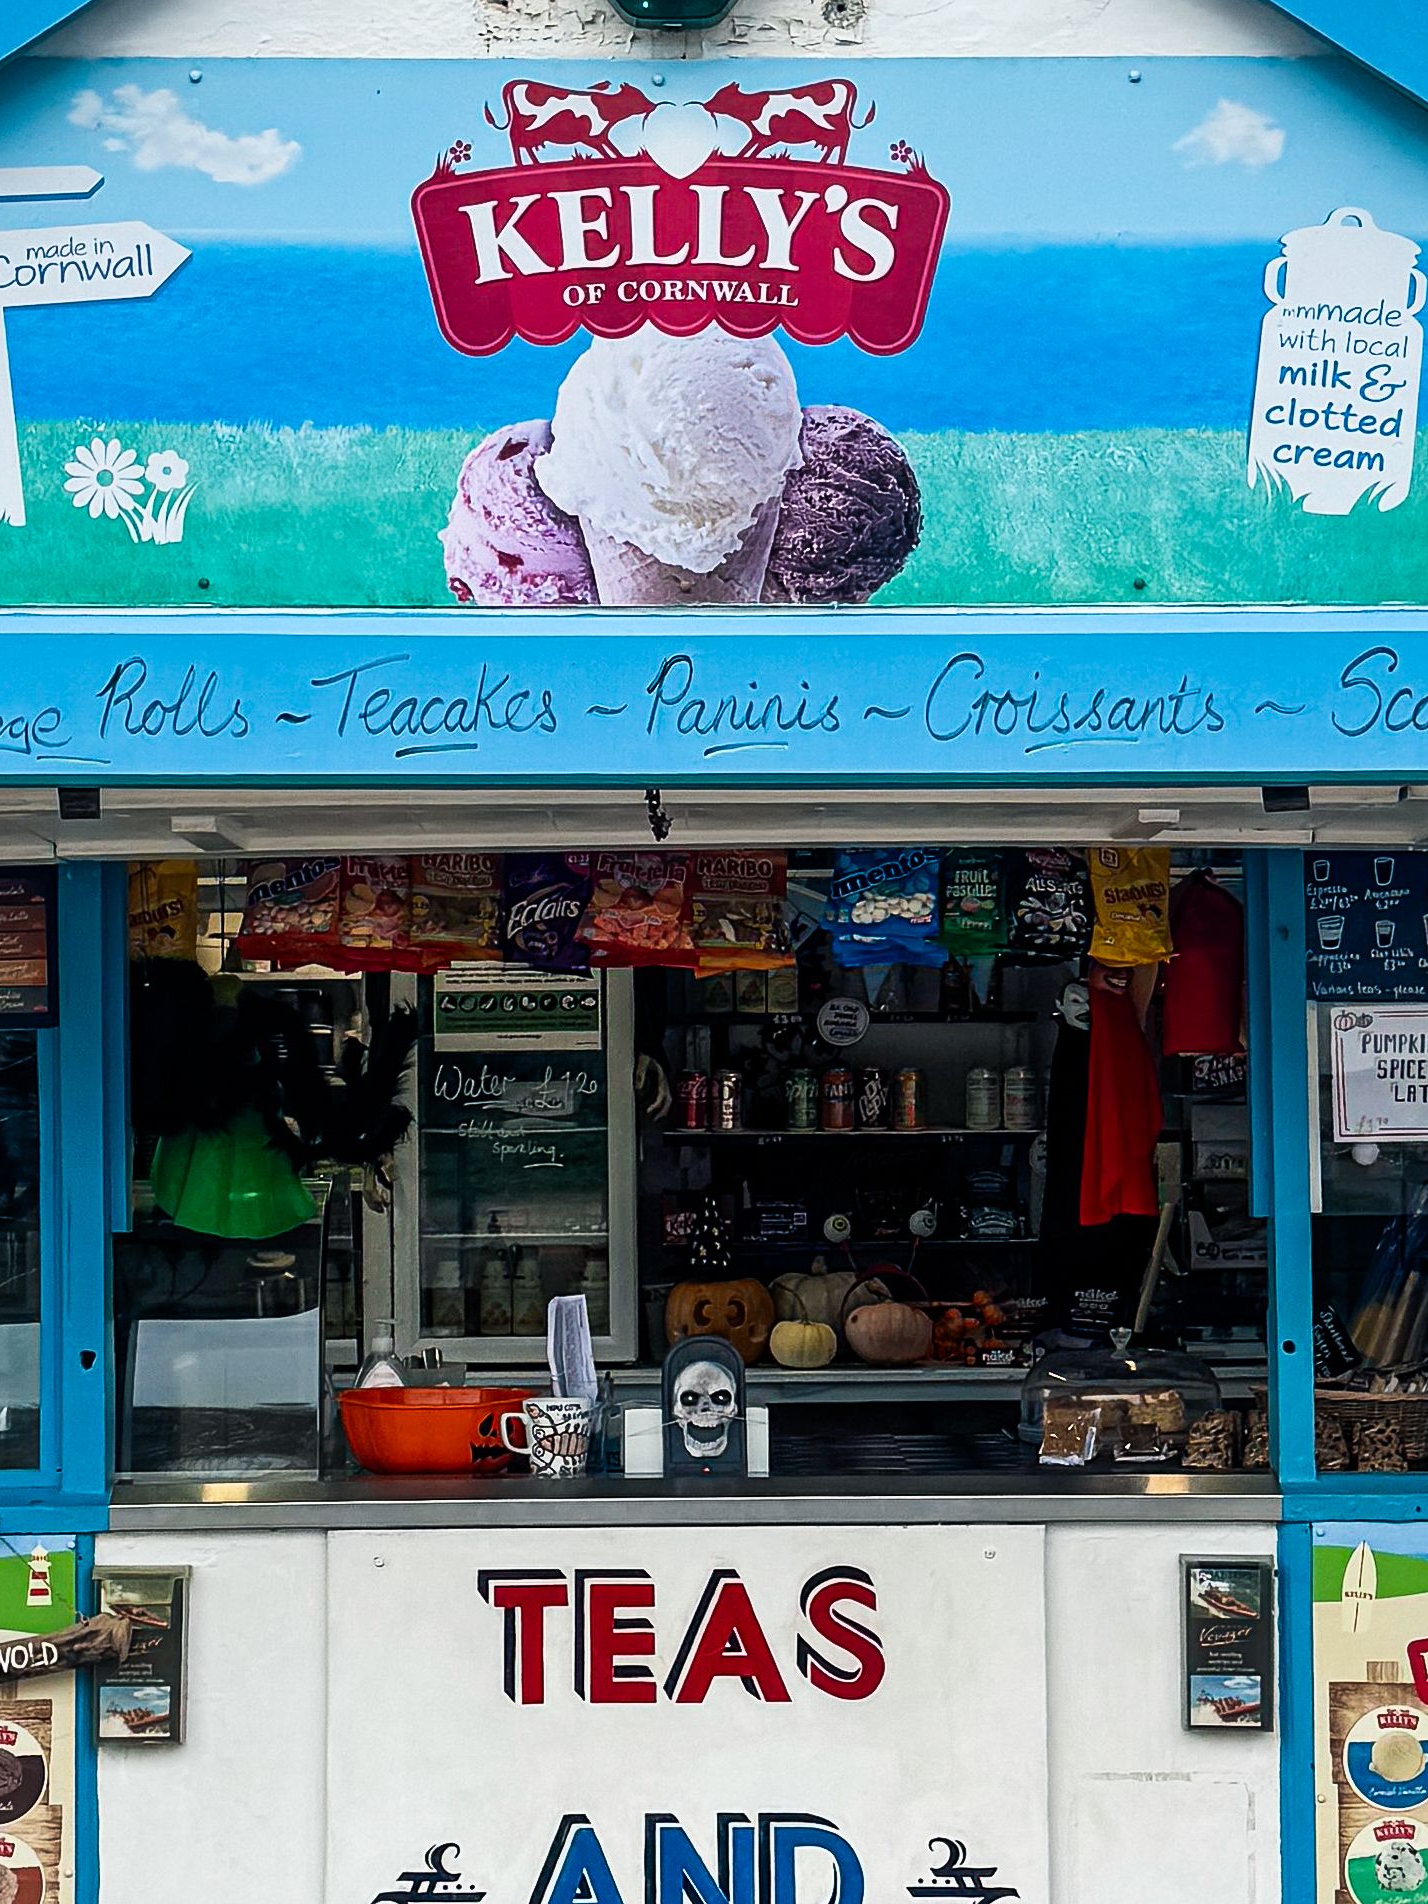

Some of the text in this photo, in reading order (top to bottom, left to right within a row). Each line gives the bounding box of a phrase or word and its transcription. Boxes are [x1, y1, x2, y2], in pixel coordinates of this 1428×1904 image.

[26, 237, 115, 261] made in
[458, 184, 898, 285] KELLY'S
[563, 279, 799, 307] OF CORNWALL
[1279, 329, 1408, 358] with local
[1279, 360, 1407, 402] milk &
[1265, 398, 1403, 437] clotted
[1273, 444, 1384, 471] cream
[97, 656, 249, 739] Rolls
[311, 654, 556, 737] Teacakes
[647, 653, 841, 736] Paninis
[925, 652, 1225, 741] Croissants
[697, 857, 773, 879] HARIBO
[434, 1064, 516, 1101] Water
[477, 1565, 886, 1705] TEAS
